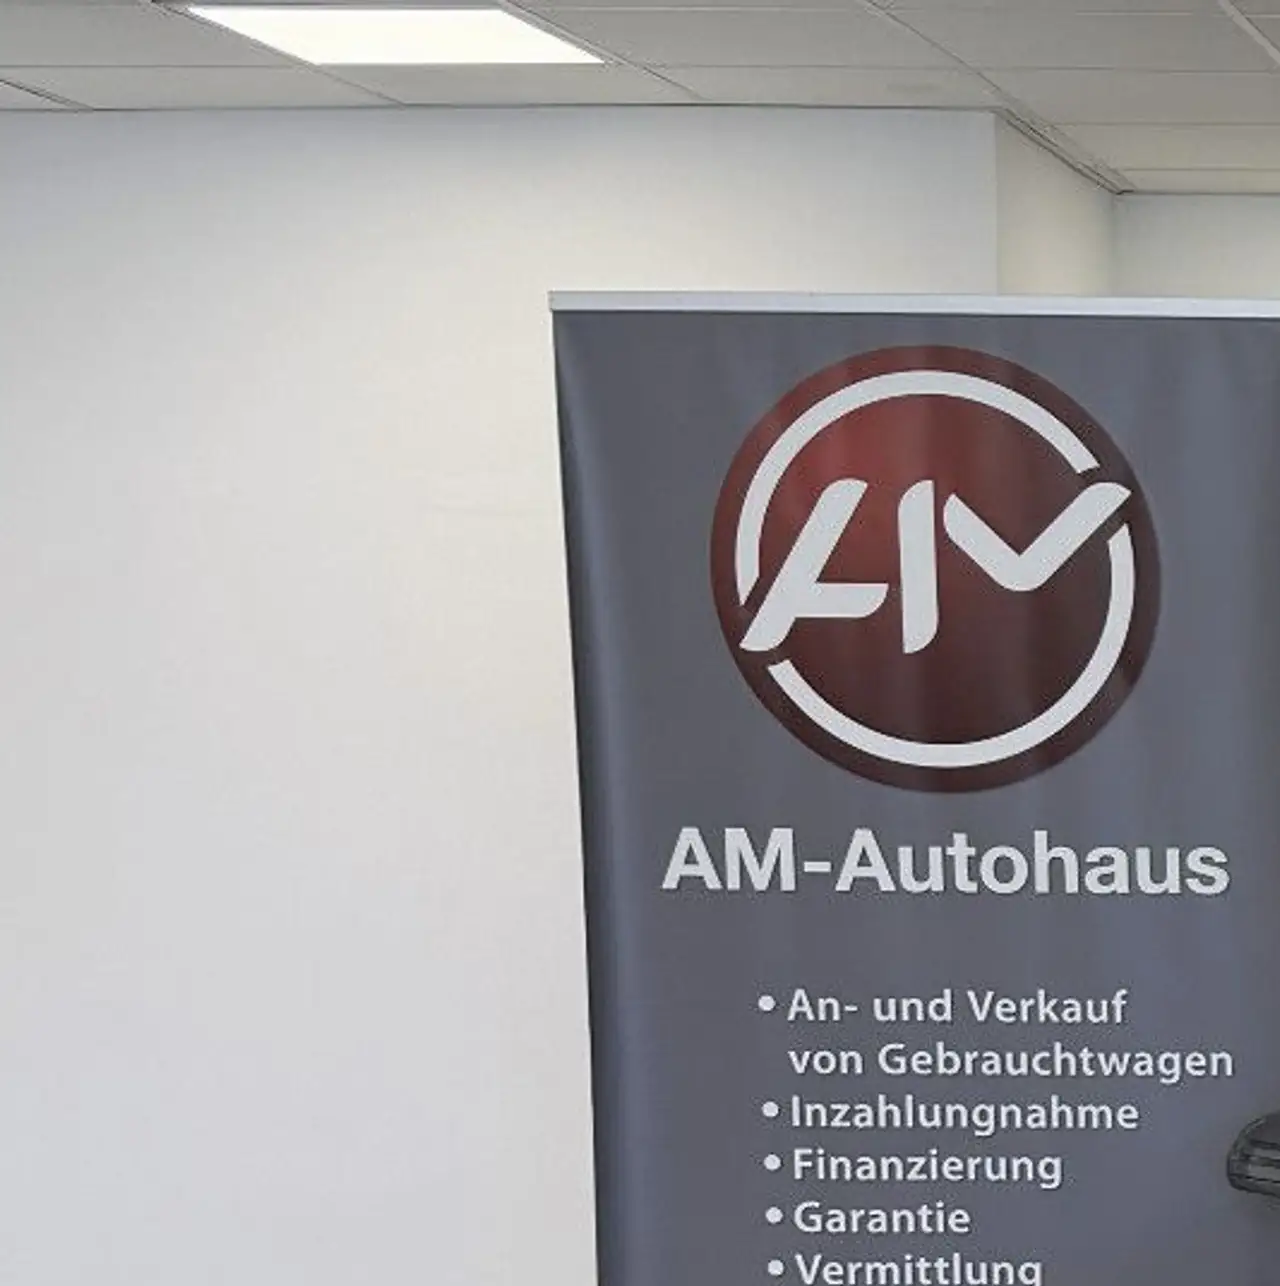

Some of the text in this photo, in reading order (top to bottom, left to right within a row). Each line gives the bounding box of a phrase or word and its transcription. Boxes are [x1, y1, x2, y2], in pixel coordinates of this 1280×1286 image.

[661, 827, 1230, 895] AM-Autohaus
[787, 988, 1128, 1024] An- und Verkauf
[787, 1041, 1233, 1085] von Gebrauchtwagen
[791, 1094, 1139, 1137] Inzahlungnahme
[793, 1147, 1063, 1189] Finanzierung
[794, 1200, 971, 1233] Garantie
